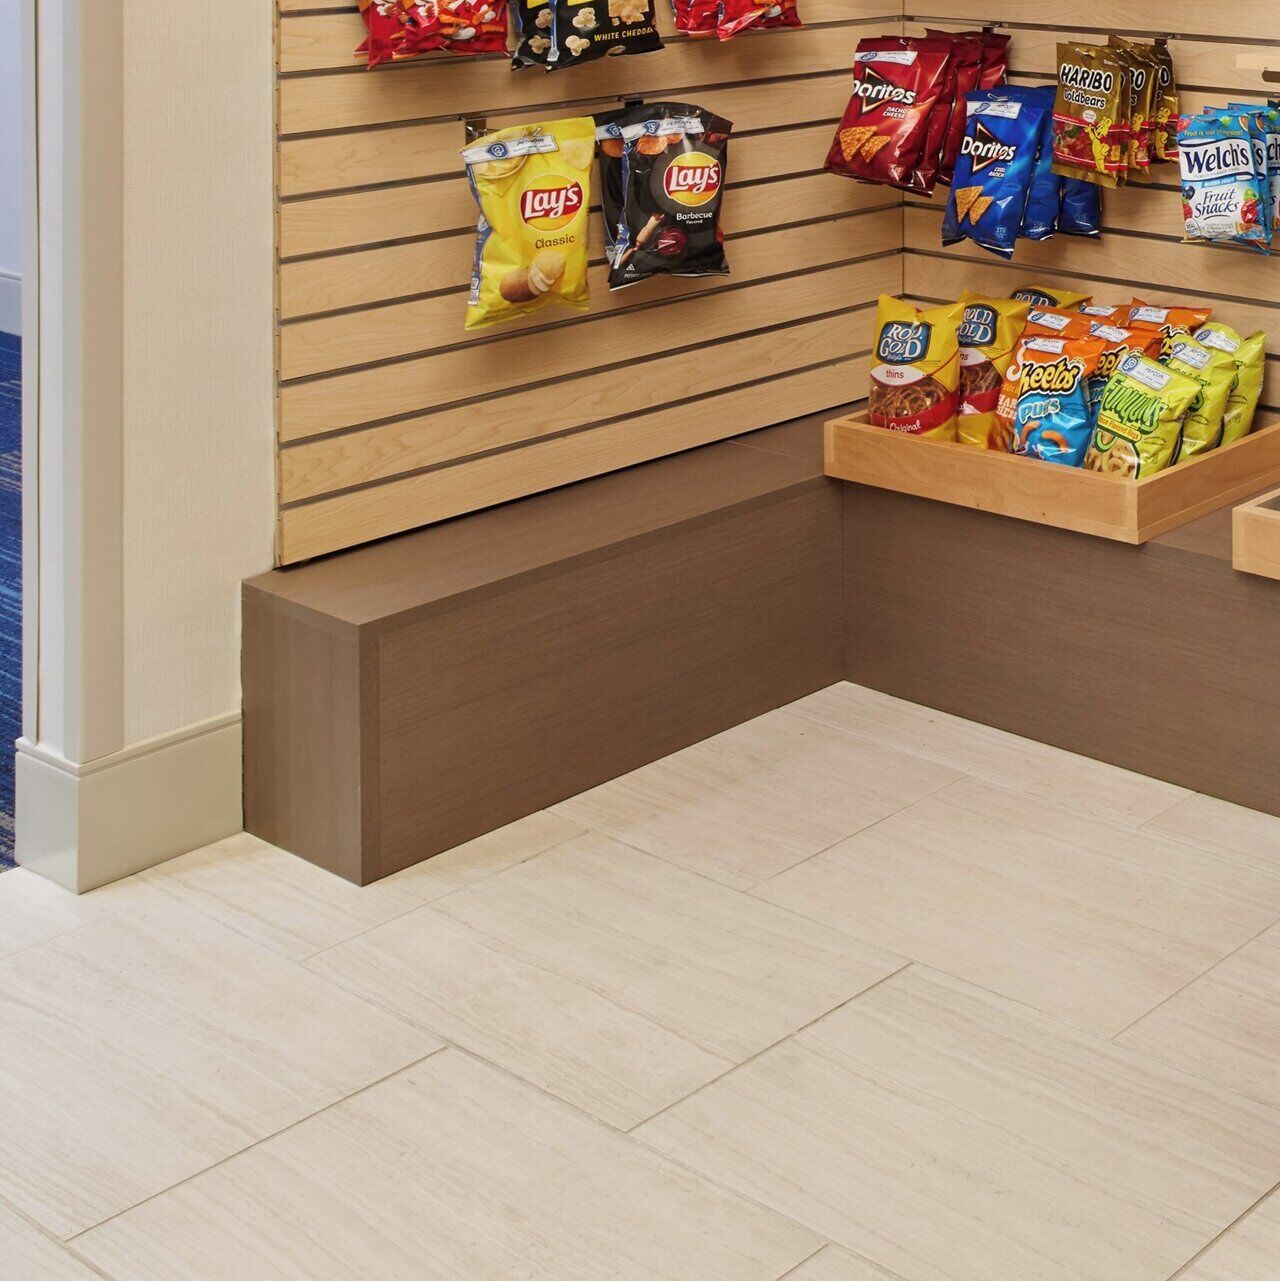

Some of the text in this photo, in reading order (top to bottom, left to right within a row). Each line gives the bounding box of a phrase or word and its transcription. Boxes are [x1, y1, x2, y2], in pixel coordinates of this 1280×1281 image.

[594, 32, 620, 42] WHITE
[1060, 64, 1113, 93] HARIBO
[961, 136, 1016, 160] Doritos
[1183, 144, 1249, 174] Welch's
[669, 163, 719, 193] Lay's
[524, 184, 580, 218] Lay's
[1203, 189, 1236, 202] Fruit
[676, 211, 712, 220] Barbecue
[1195, 200, 1240, 218] Snacks
[535, 233, 575, 249] Classic
[886, 369, 904, 379] thins
